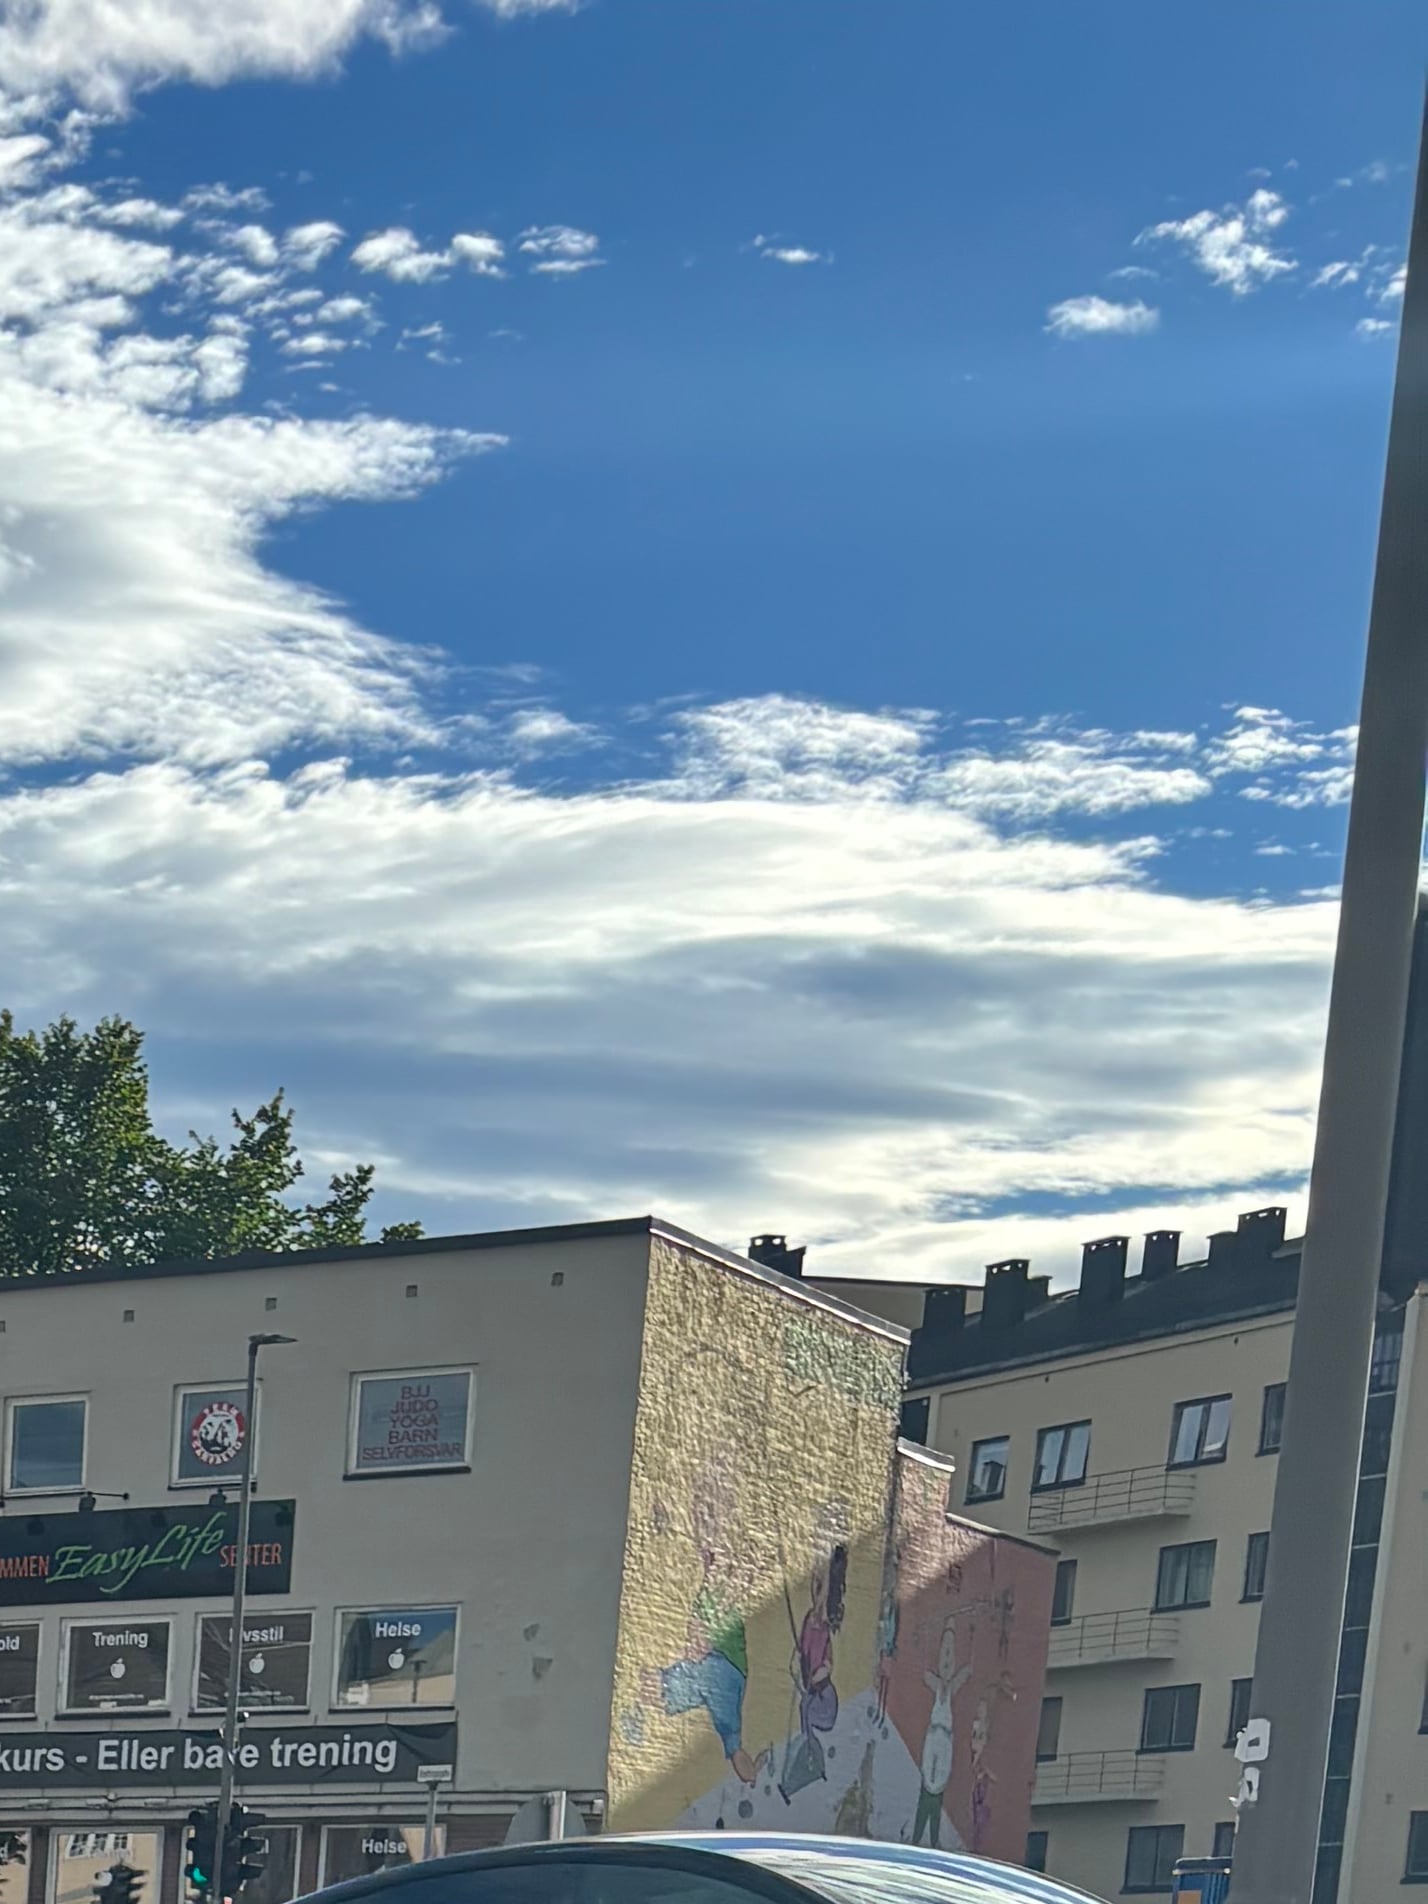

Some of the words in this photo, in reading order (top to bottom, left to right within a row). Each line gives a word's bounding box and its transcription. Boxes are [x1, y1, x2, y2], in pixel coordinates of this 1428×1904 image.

[391, 1399, 438, 1414] JUDO
[390, 1414, 438, 1428] YOGA
[389, 1429, 438, 1444] BARN
[46, 1511, 227, 1593] EasyLife
[229, 1626, 283, 1642] Lvsstil
[376, 1622, 421, 1638] Helse
[93, 1630, 148, 1648] Trening
[98, 1739, 174, 1770] Eller
[184, 1738, 259, 1769] bae
[270, 1734, 397, 1773] trening
[362, 1839, 407, 1854] Helse
